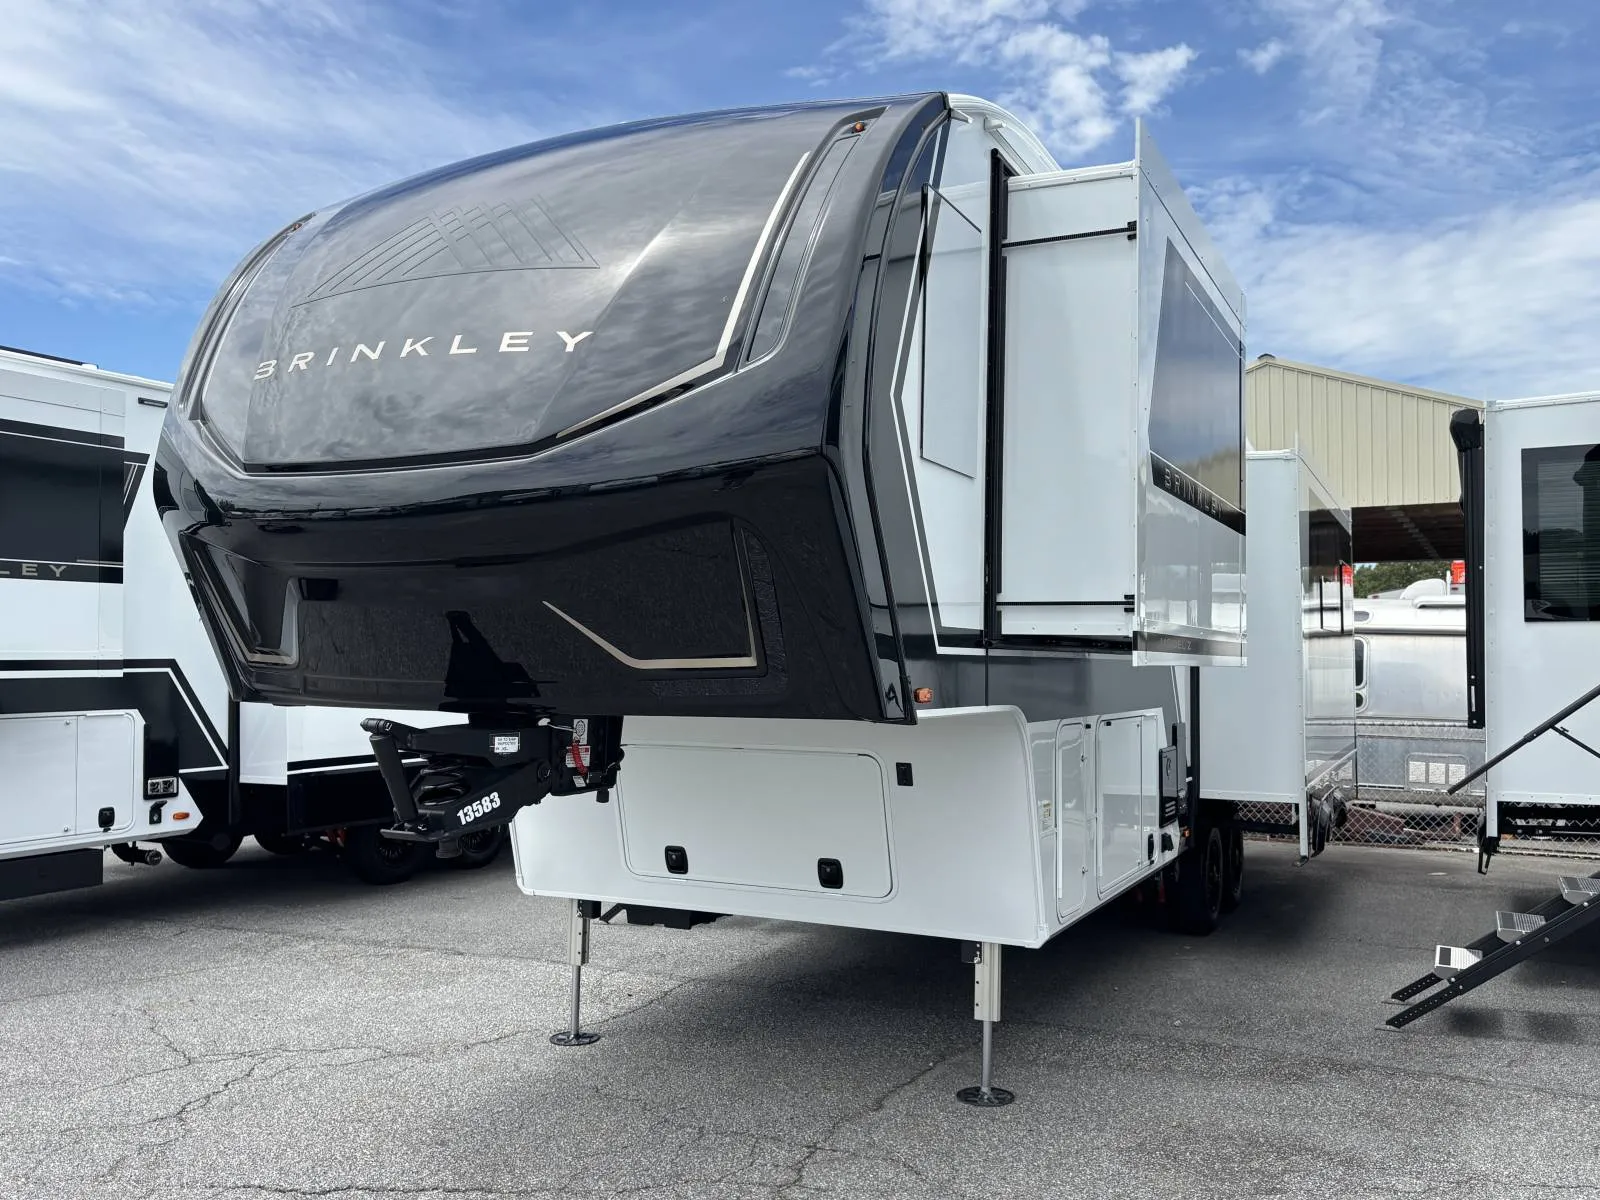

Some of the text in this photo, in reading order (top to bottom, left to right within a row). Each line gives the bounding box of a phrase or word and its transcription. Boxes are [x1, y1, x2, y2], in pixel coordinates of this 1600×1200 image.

[253, 331, 594, 381] BRINKLEY
[1164, 467, 1223, 520] BRINKLEY
[456, 791, 501, 826] 13583
